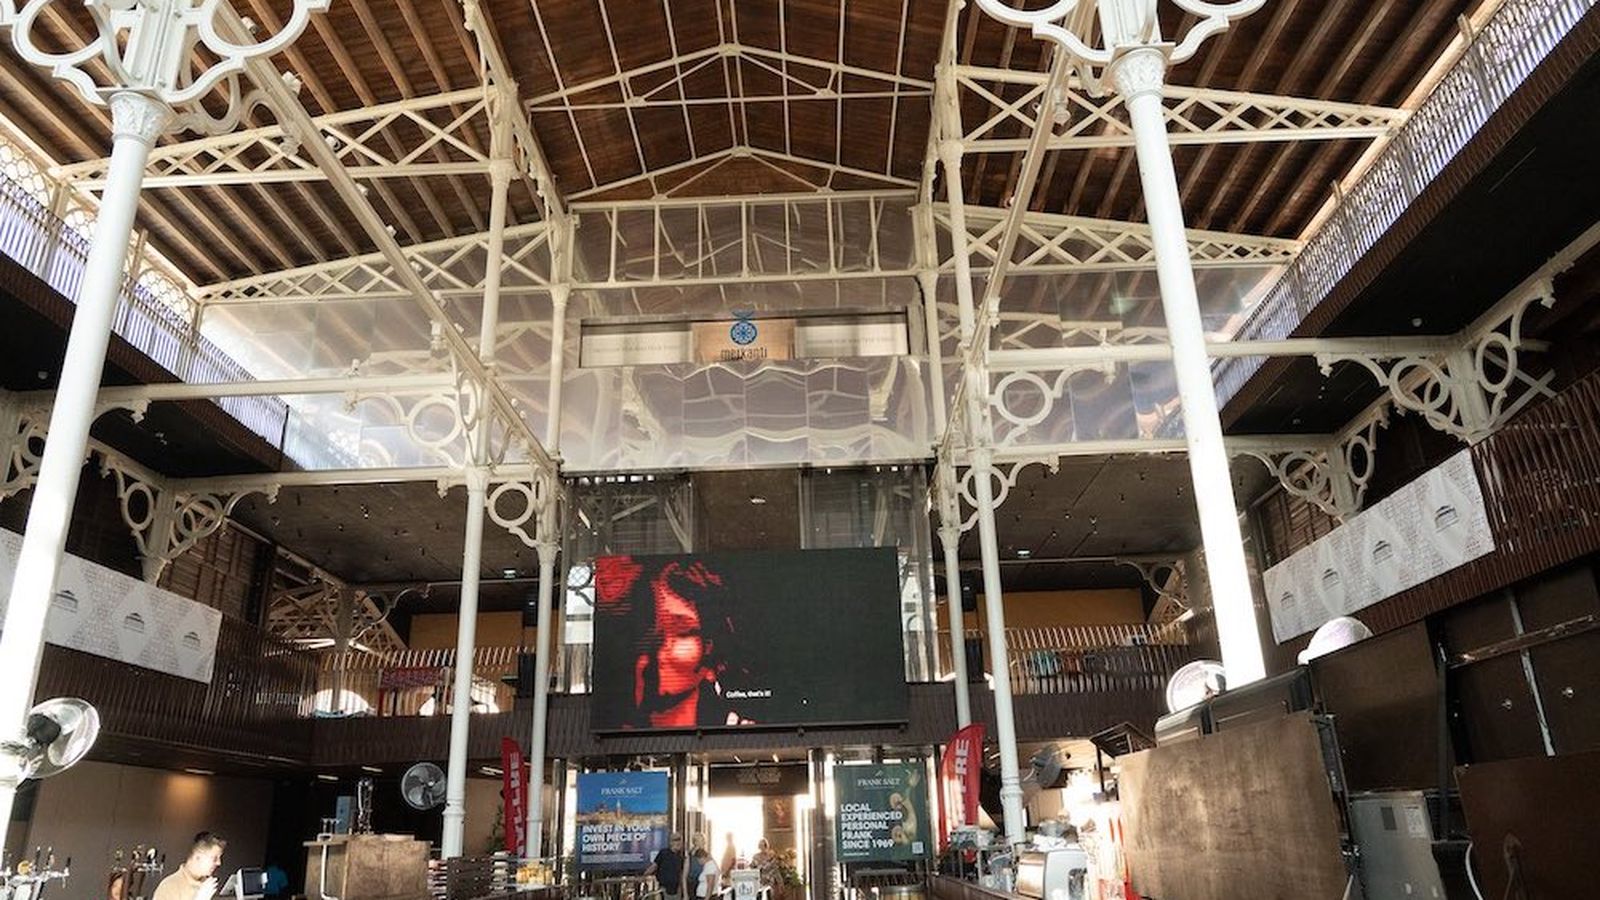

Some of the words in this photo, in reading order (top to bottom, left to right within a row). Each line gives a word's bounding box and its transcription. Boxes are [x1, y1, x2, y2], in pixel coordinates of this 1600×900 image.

[857, 778, 882, 786] FRANK
[883, 778, 900, 786] SALT
[601, 787, 625, 795] FRANK
[626, 787, 643, 795] SALT
[841, 803, 871, 812] LOCAL
[841, 811, 903, 821] EXPERIENCED
[582, 824, 613, 833] INVEST
[615, 824, 625, 832] IN
[627, 824, 652, 832] YOUR
[841, 821, 889, 831] PERSONAL
[582, 833, 605, 843] OWN
[606, 833, 632, 842] PIECE
[841, 830, 873, 840] FRANK
[582, 843, 620, 852] HISTORY
[842, 840, 870, 849] SINCE
[872, 839, 895, 848] 1969
